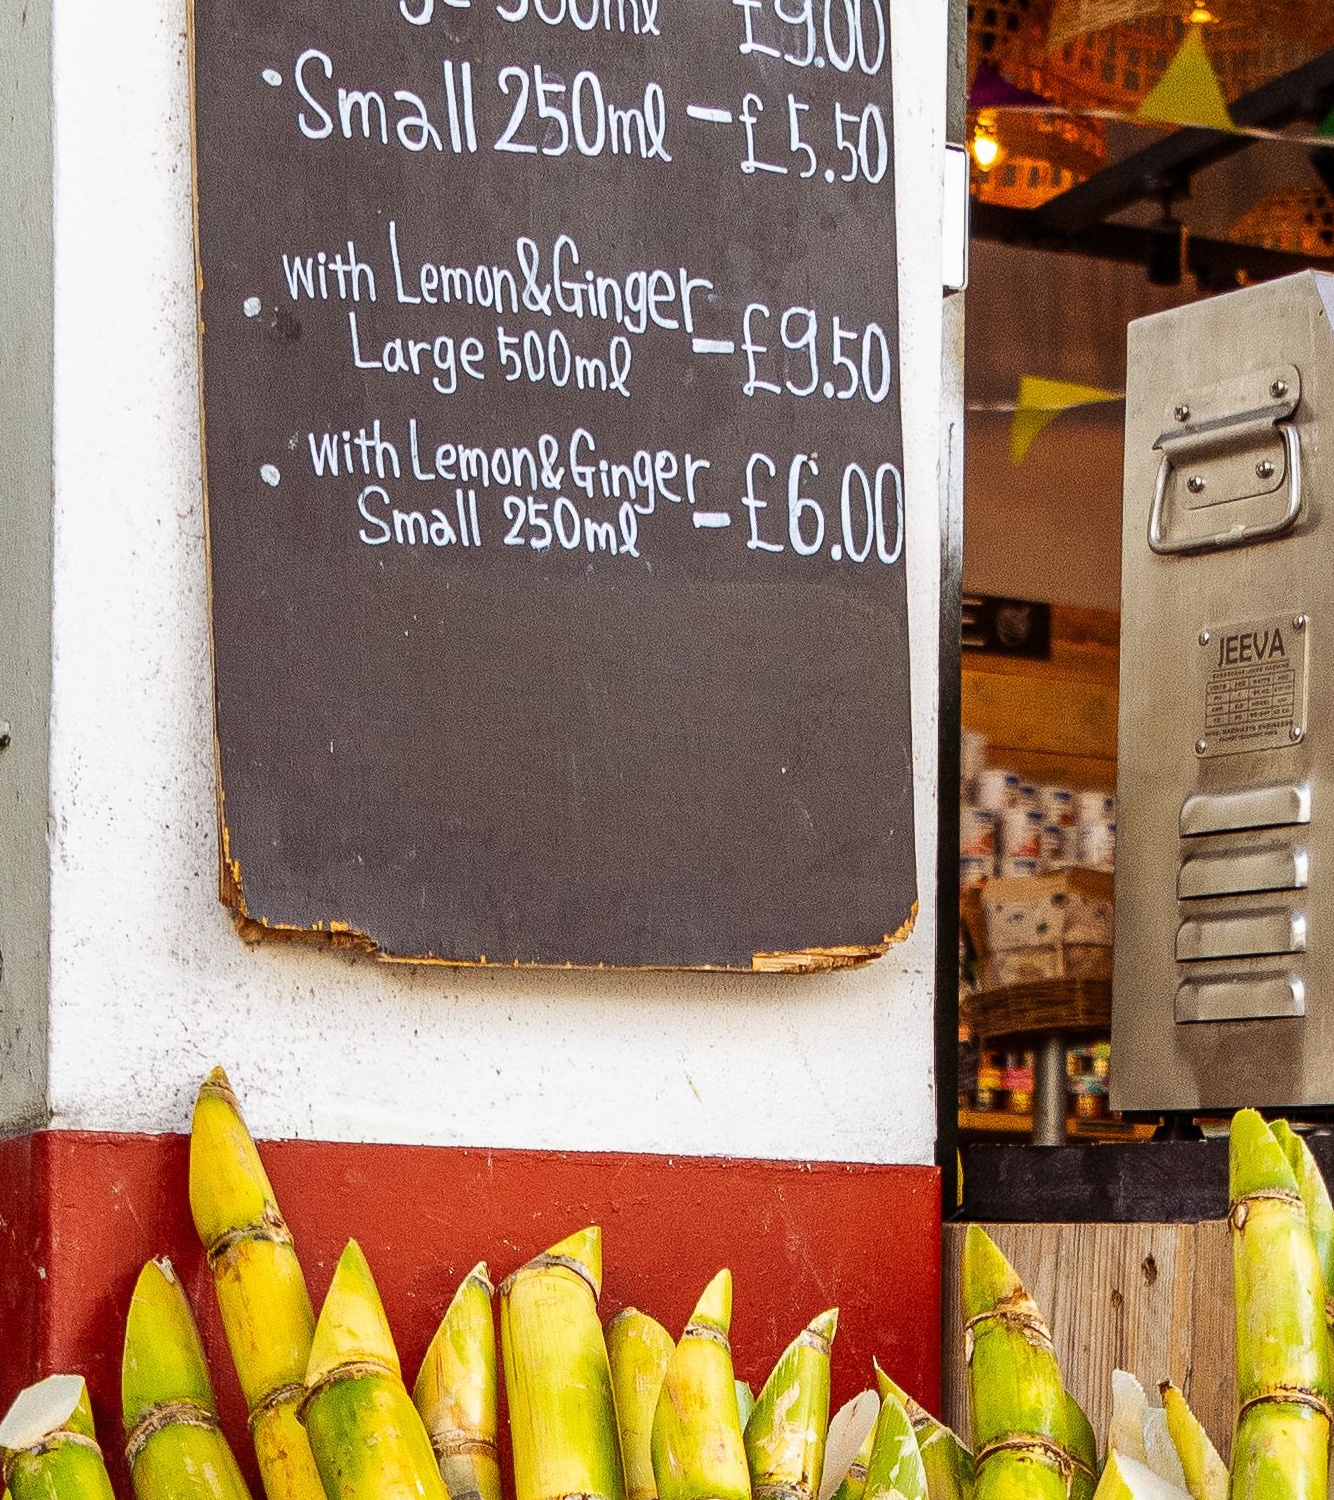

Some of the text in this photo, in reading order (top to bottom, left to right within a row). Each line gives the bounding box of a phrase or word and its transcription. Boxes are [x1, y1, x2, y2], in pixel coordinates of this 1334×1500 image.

[293, 49, 478, 154] Small
[493, 65, 673, 163] 250ml
[282, 243, 377, 303] with
[348, 310, 485, 394] Large
[496, 325, 632, 398] 500ml
[307, 418, 402, 480] with
[358, 486, 481, 548] Small
[501, 493, 641, 558] 250ml
[1217, 627, 1287, 668] JEEVA
